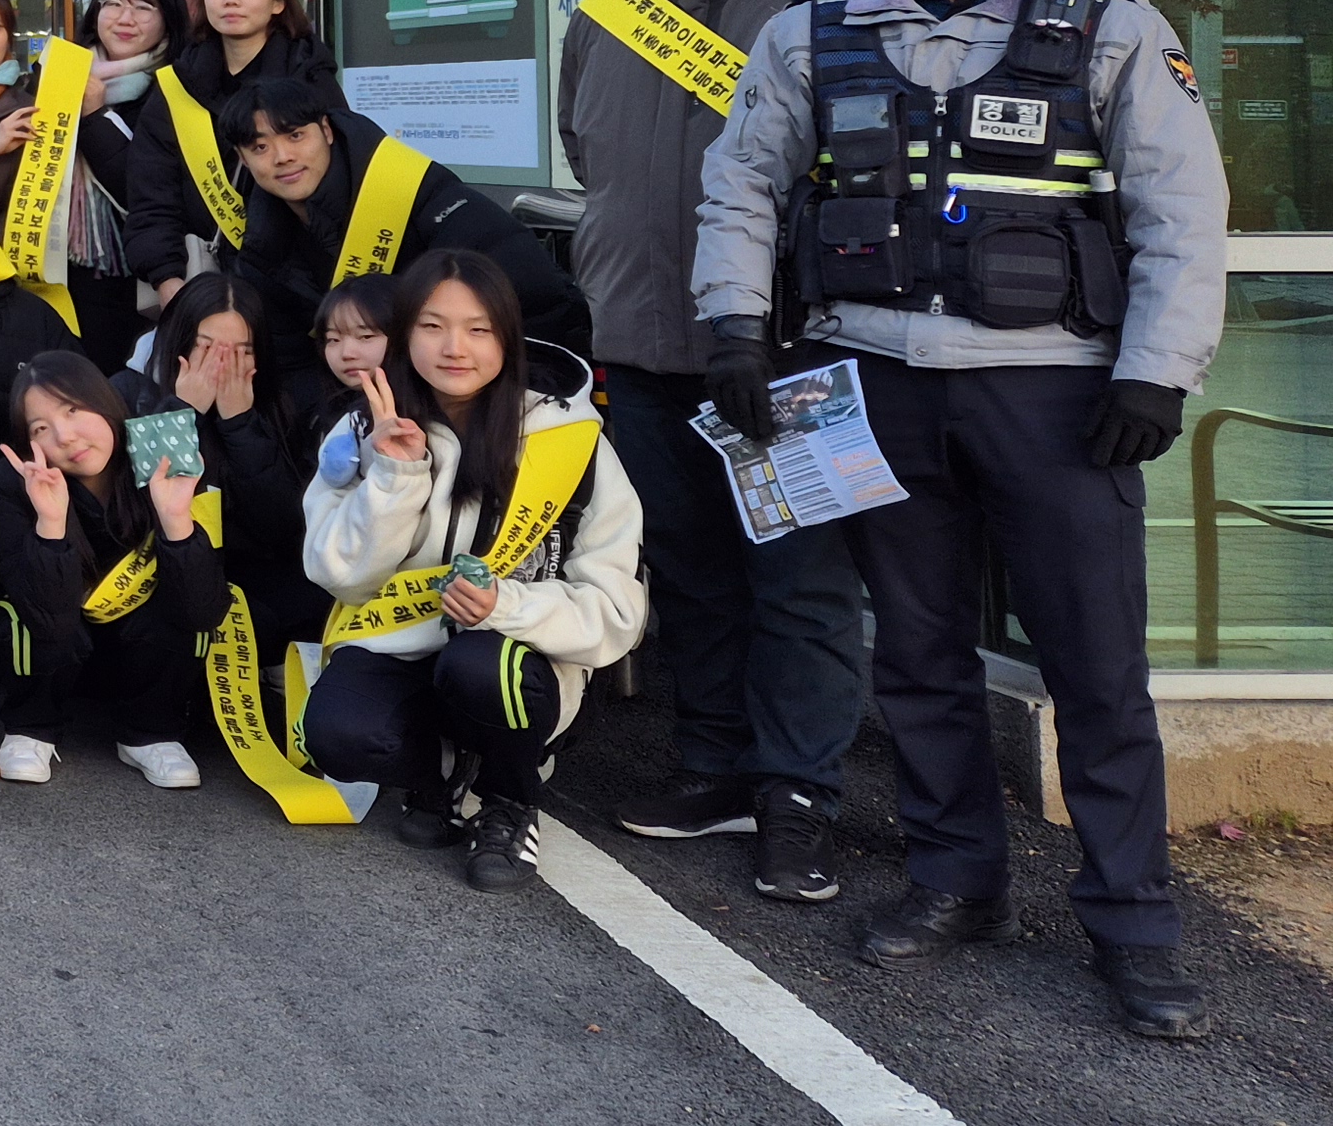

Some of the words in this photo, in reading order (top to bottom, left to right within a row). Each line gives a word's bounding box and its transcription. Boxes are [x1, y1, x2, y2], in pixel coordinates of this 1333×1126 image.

[39, 111, 72, 193] 일탈행동을
[979, 123, 1039, 140] POLICE
[11, 171, 38, 226] 고등학교
[26, 197, 48, 248] 제보해
